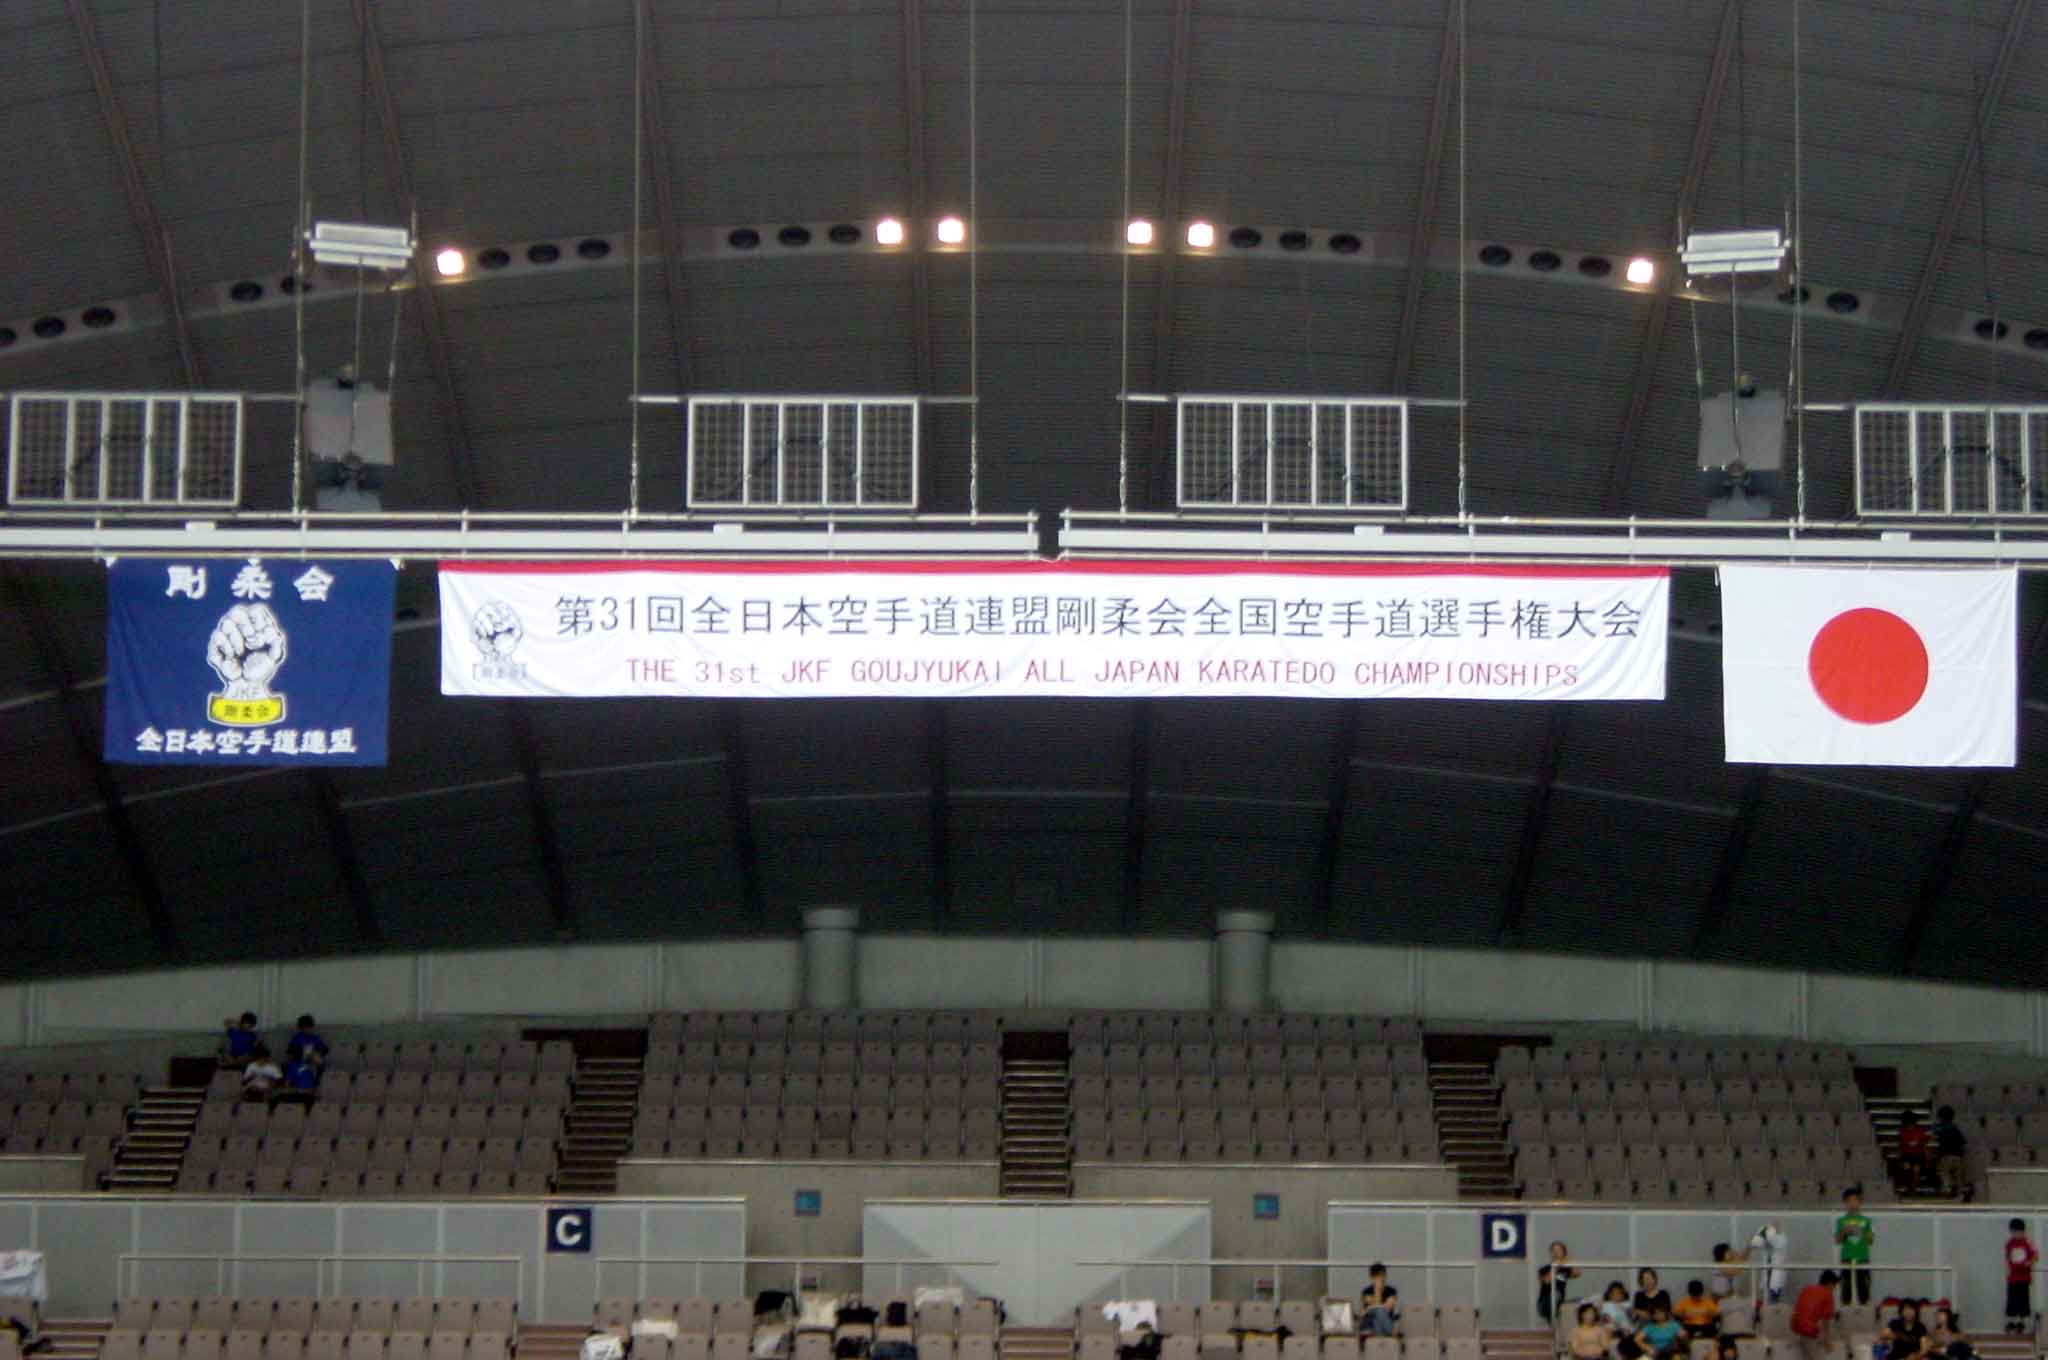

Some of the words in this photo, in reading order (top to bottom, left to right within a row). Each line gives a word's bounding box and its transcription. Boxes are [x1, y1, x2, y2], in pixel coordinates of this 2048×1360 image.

[555, 595, 1642, 639] 第31回全日本空手道連盟剛柔会全国空手道選手権大会
[626, 658, 676, 684] THE
[695, 660, 761, 684] 31st
[781, 659, 831, 684] JKF
[850, 659, 1001, 683] GOUJYUKAI
[1025, 659, 1075, 683] ALL
[1094, 659, 1180, 683] JAPAN
[1198, 659, 1336, 685] KARATEDO
[1354, 661, 1578, 687] CHAMPIONSHIPS
[556, 1215, 582, 1246] C
[1491, 1220, 1518, 1250] D
